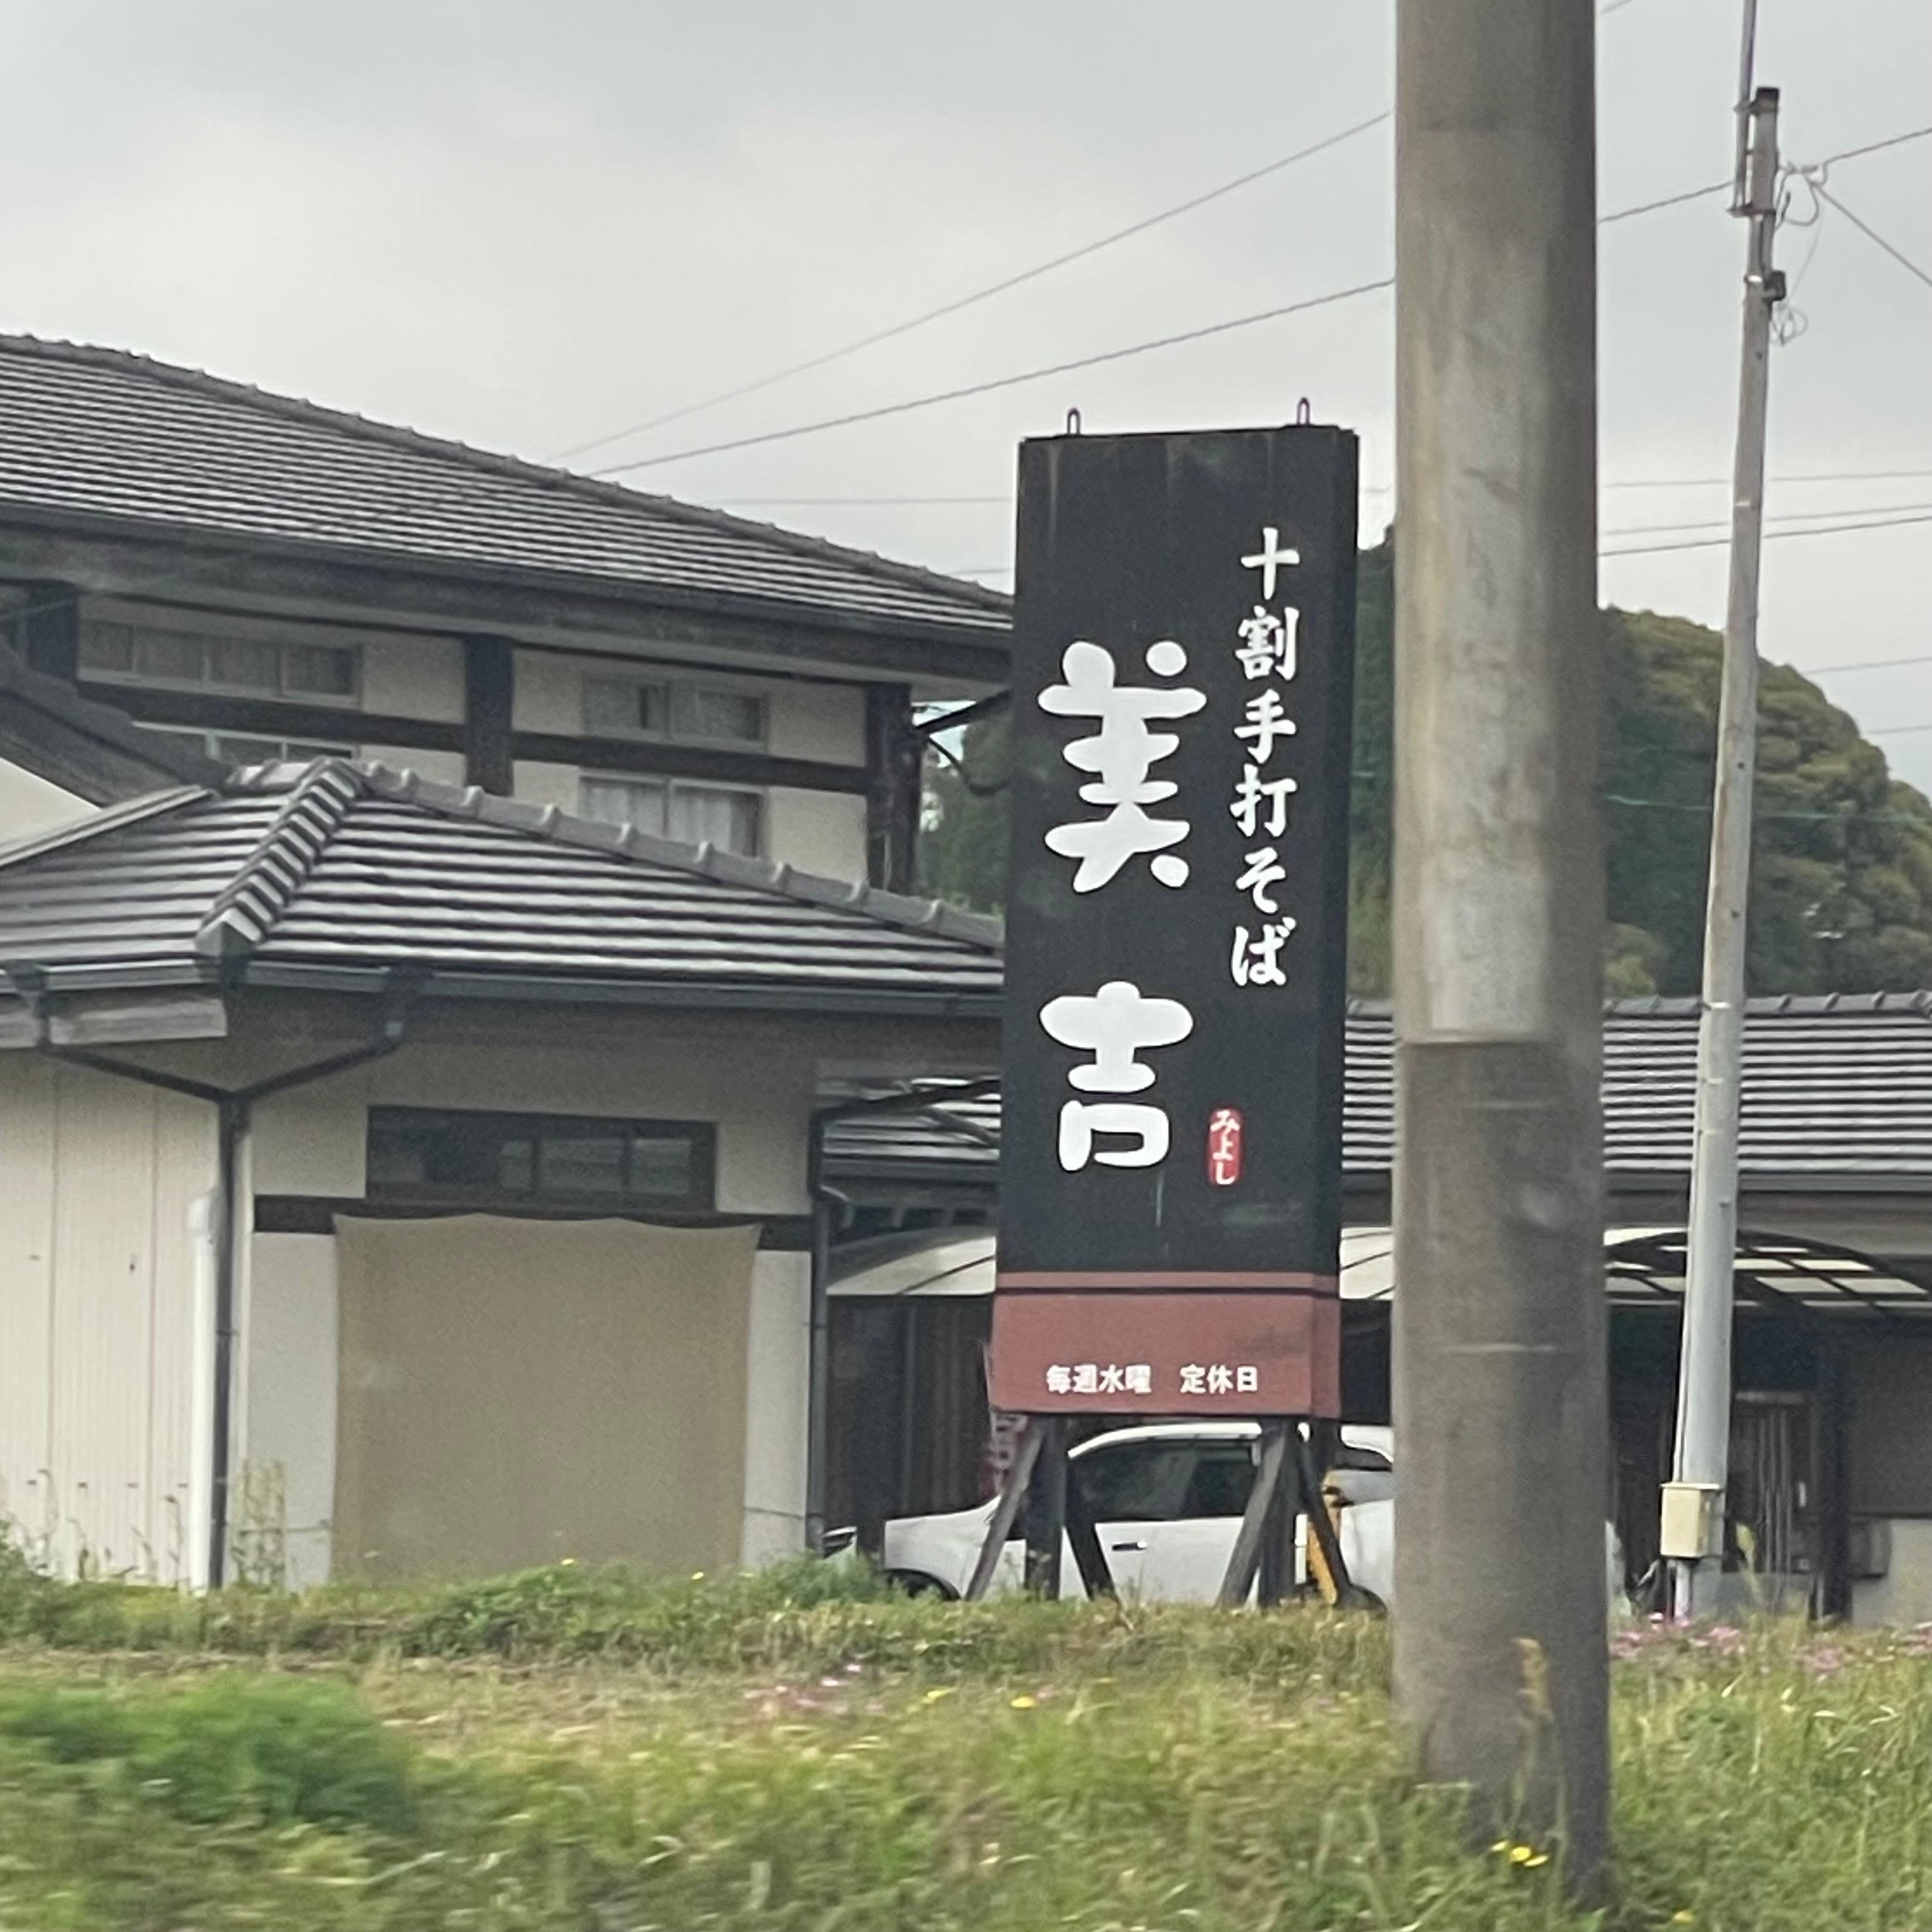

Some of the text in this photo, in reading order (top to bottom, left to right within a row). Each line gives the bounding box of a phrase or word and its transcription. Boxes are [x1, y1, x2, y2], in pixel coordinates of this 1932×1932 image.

[1230, 526, 1301, 988] 十割手打そば
[1037, 640, 1208, 1172] 美吉
[1209, 1109, 1240, 1185] みよし
[1046, 1363, 1258, 1395] 毎週水曜 定休日
